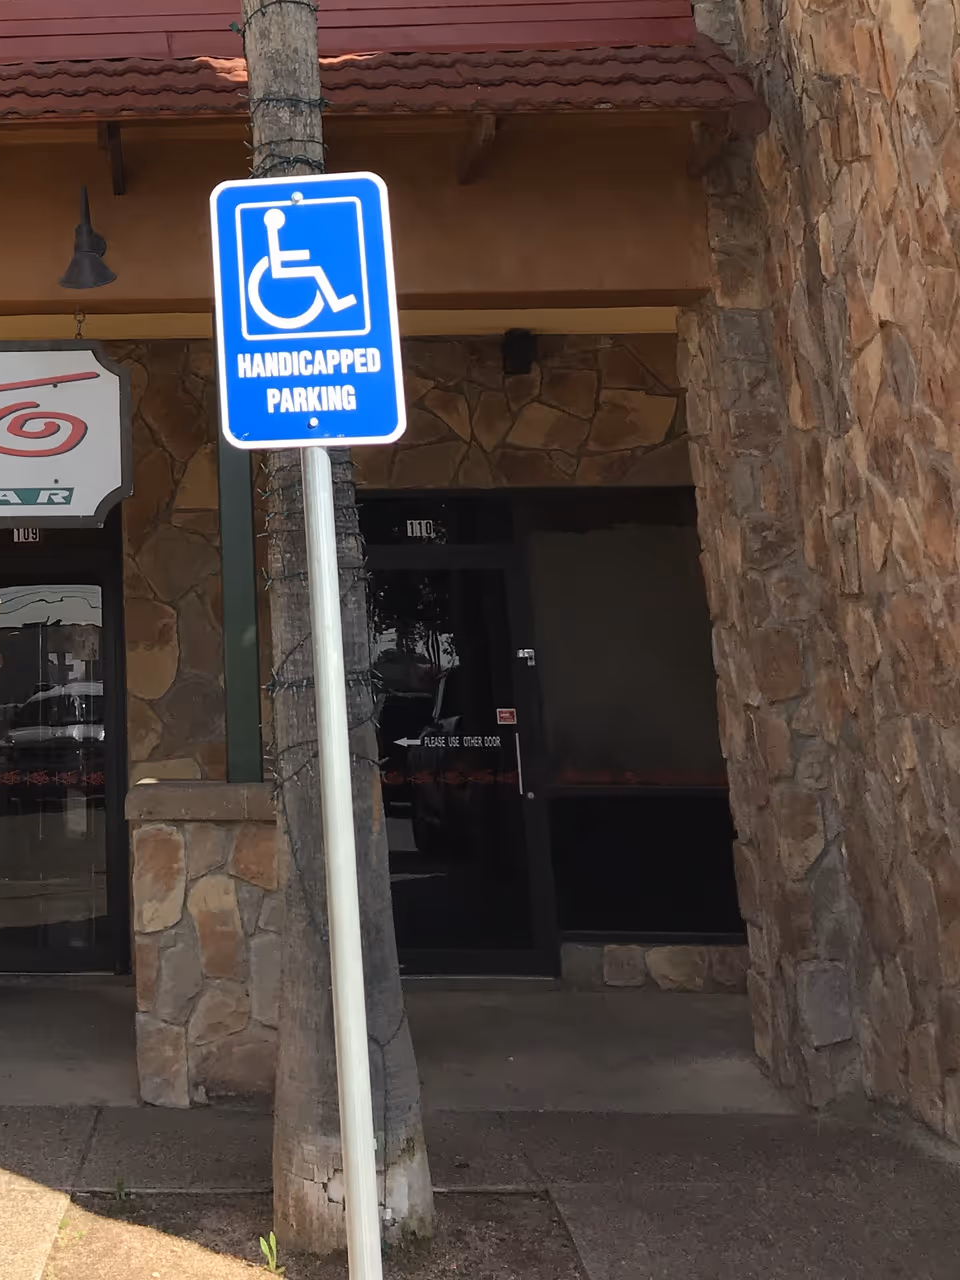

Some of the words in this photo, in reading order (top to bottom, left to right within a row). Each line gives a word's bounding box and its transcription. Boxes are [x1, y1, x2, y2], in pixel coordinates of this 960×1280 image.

[237, 347, 381, 378] HANDICAPPED
[267, 384, 357, 413] PARKING
[14, 527, 39, 542] 109
[407, 520, 434, 537] 110
[424, 736, 445, 747] PLEASE
[448, 736, 460, 747] USE
[463, 735, 483, 747] OTHER
[484, 735, 501, 747] DOOR
